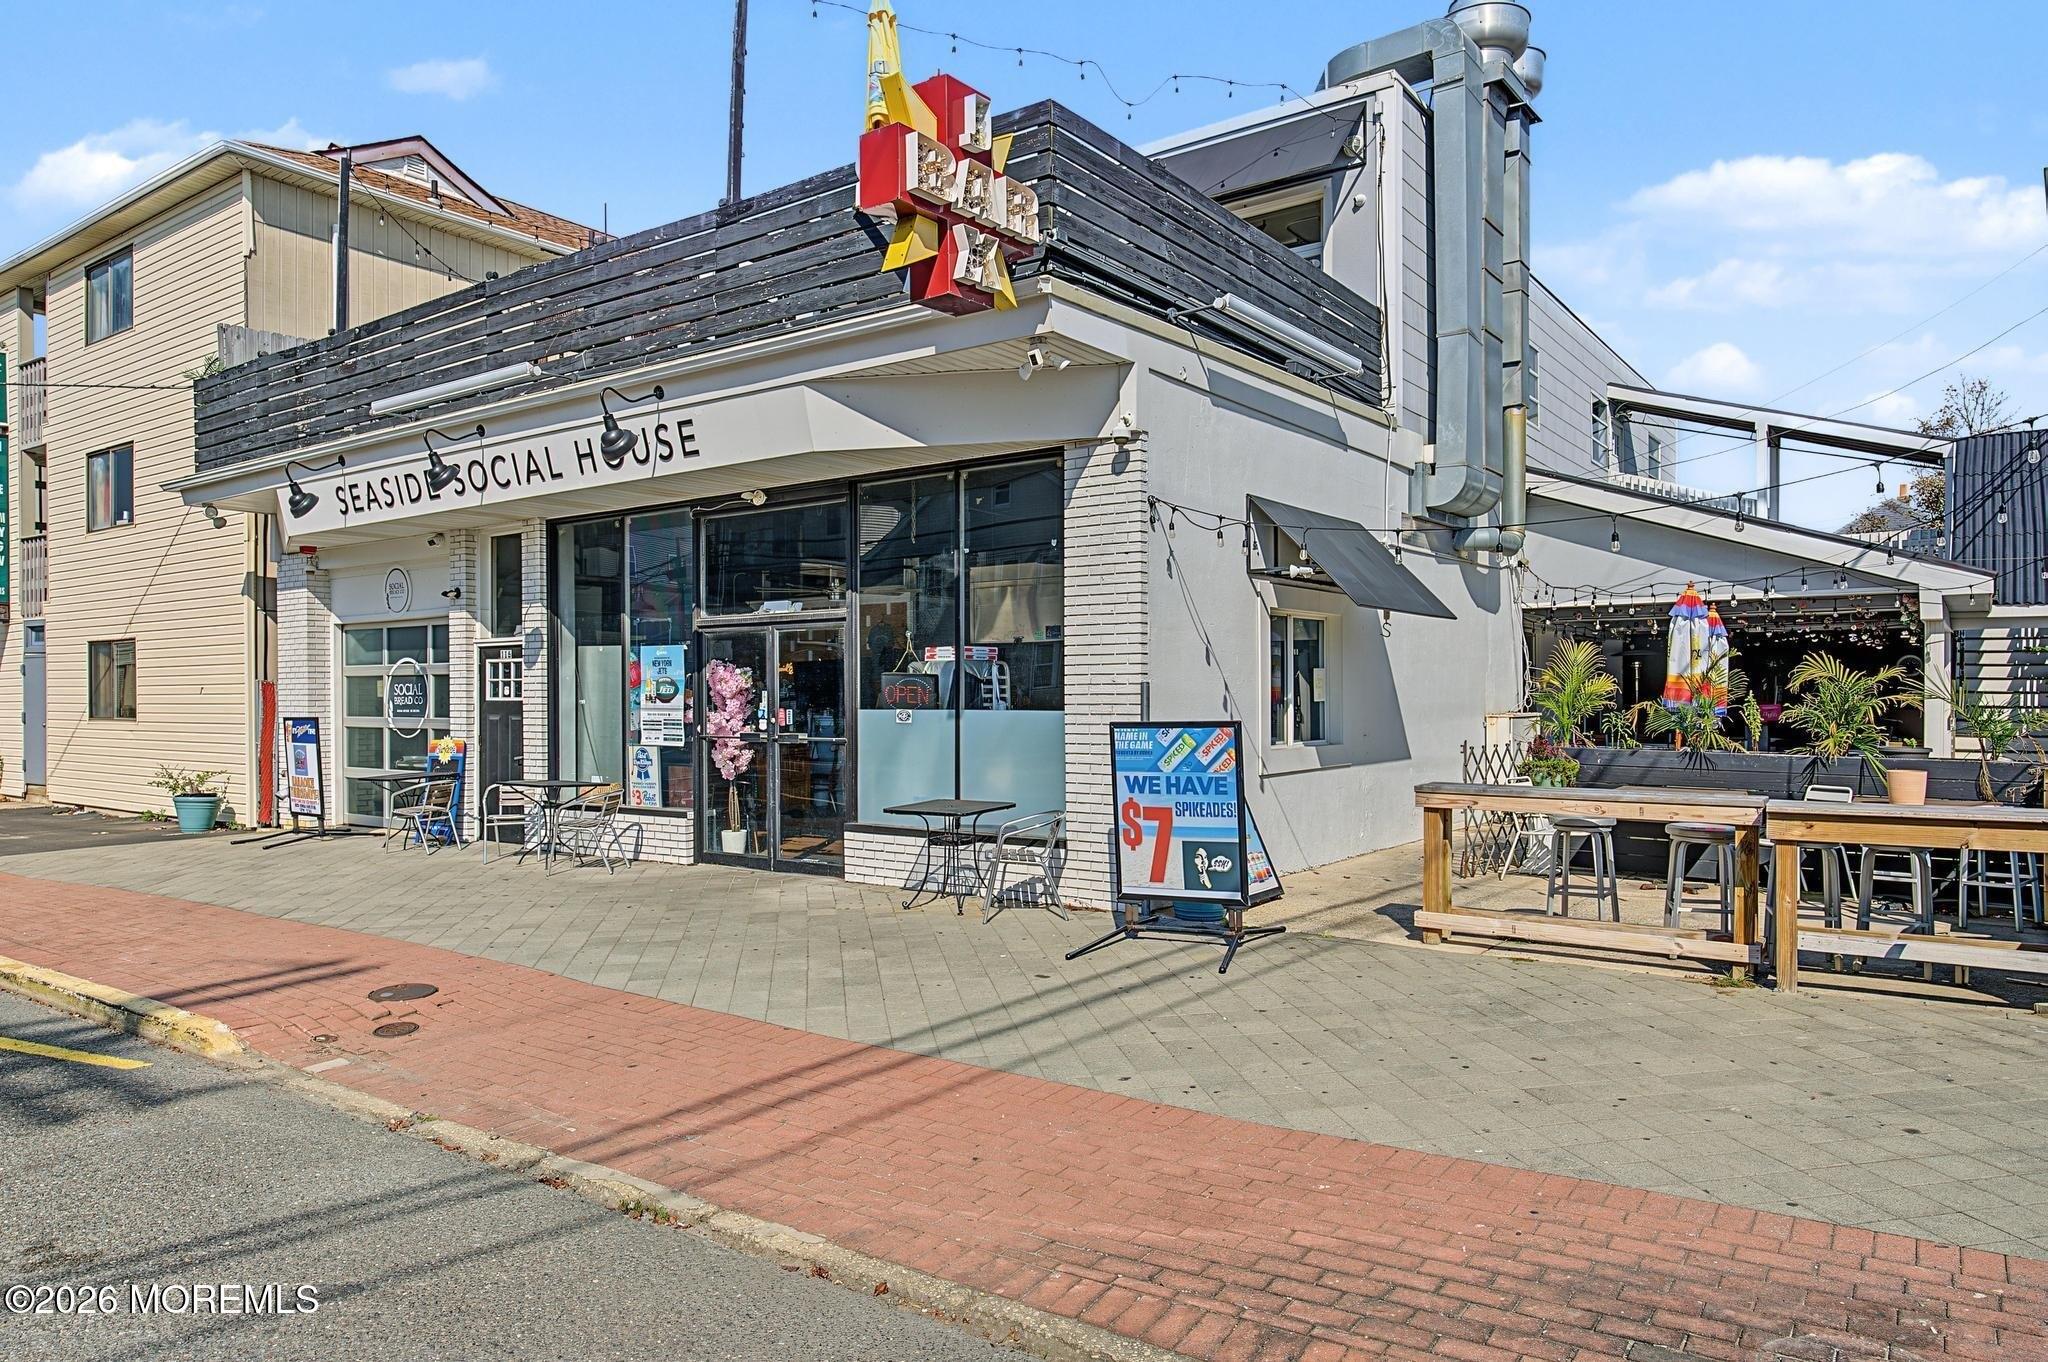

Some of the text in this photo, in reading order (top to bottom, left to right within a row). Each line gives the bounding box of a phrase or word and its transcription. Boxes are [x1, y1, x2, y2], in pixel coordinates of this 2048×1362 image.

[905, 131, 1040, 244] BAR
[453, 445, 563, 497] SOCIAL
[389, 582, 405, 590] SOCIAL
[657, 667, 667, 675] JETS
[394, 683, 422, 696] SOCIAL
[883, 685, 930, 705] OPEN
[393, 696, 424, 705] BREAD CO
[1130, 741, 1153, 749] GAME
[1124, 776, 1228, 796] WE HAVE
[1175, 802, 1237, 818] SPIKEADES!
[1122, 797, 1173, 882] $7
